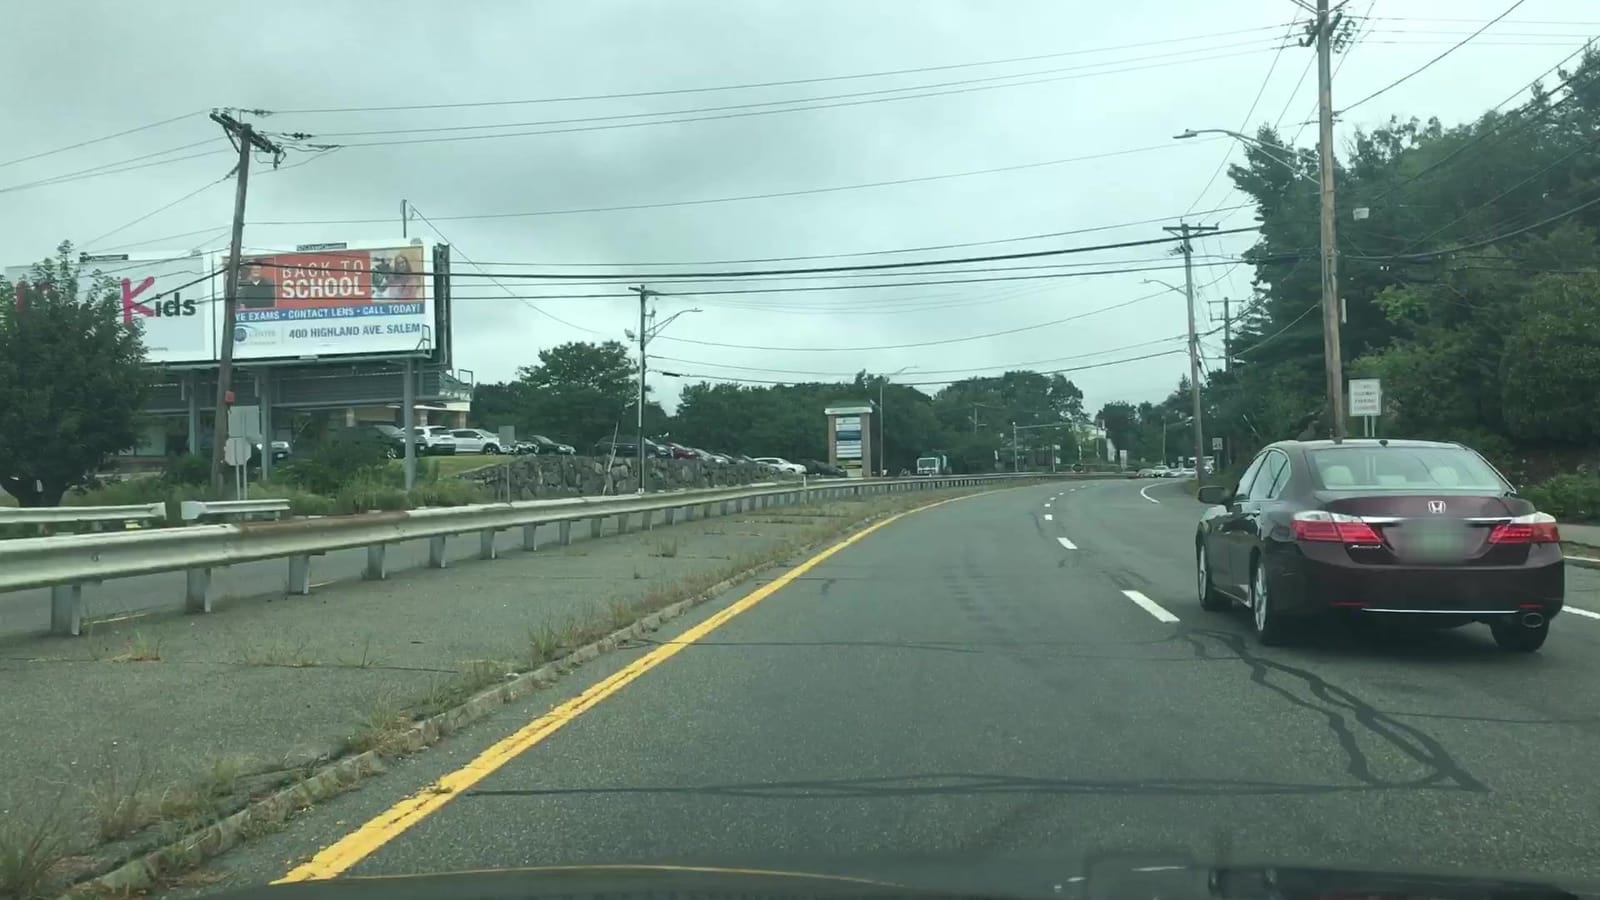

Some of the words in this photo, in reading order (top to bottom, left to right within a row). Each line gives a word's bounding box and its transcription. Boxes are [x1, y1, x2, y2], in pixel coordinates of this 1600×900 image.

[282, 262, 331, 279] BACK
[341, 259, 365, 276] TO
[282, 276, 366, 299] SCHOOL
[121, 276, 197, 328] Kids
[249, 310, 280, 321] EXAMS
[288, 308, 328, 319] CONTACT
[331, 307, 354, 318] LENS
[363, 305, 385, 315] CALL
[388, 303, 421, 314] TODAY!
[289, 328, 308, 340] 400
[310, 325, 359, 338] HIGHLAND
[386, 323, 421, 335] SALEM
